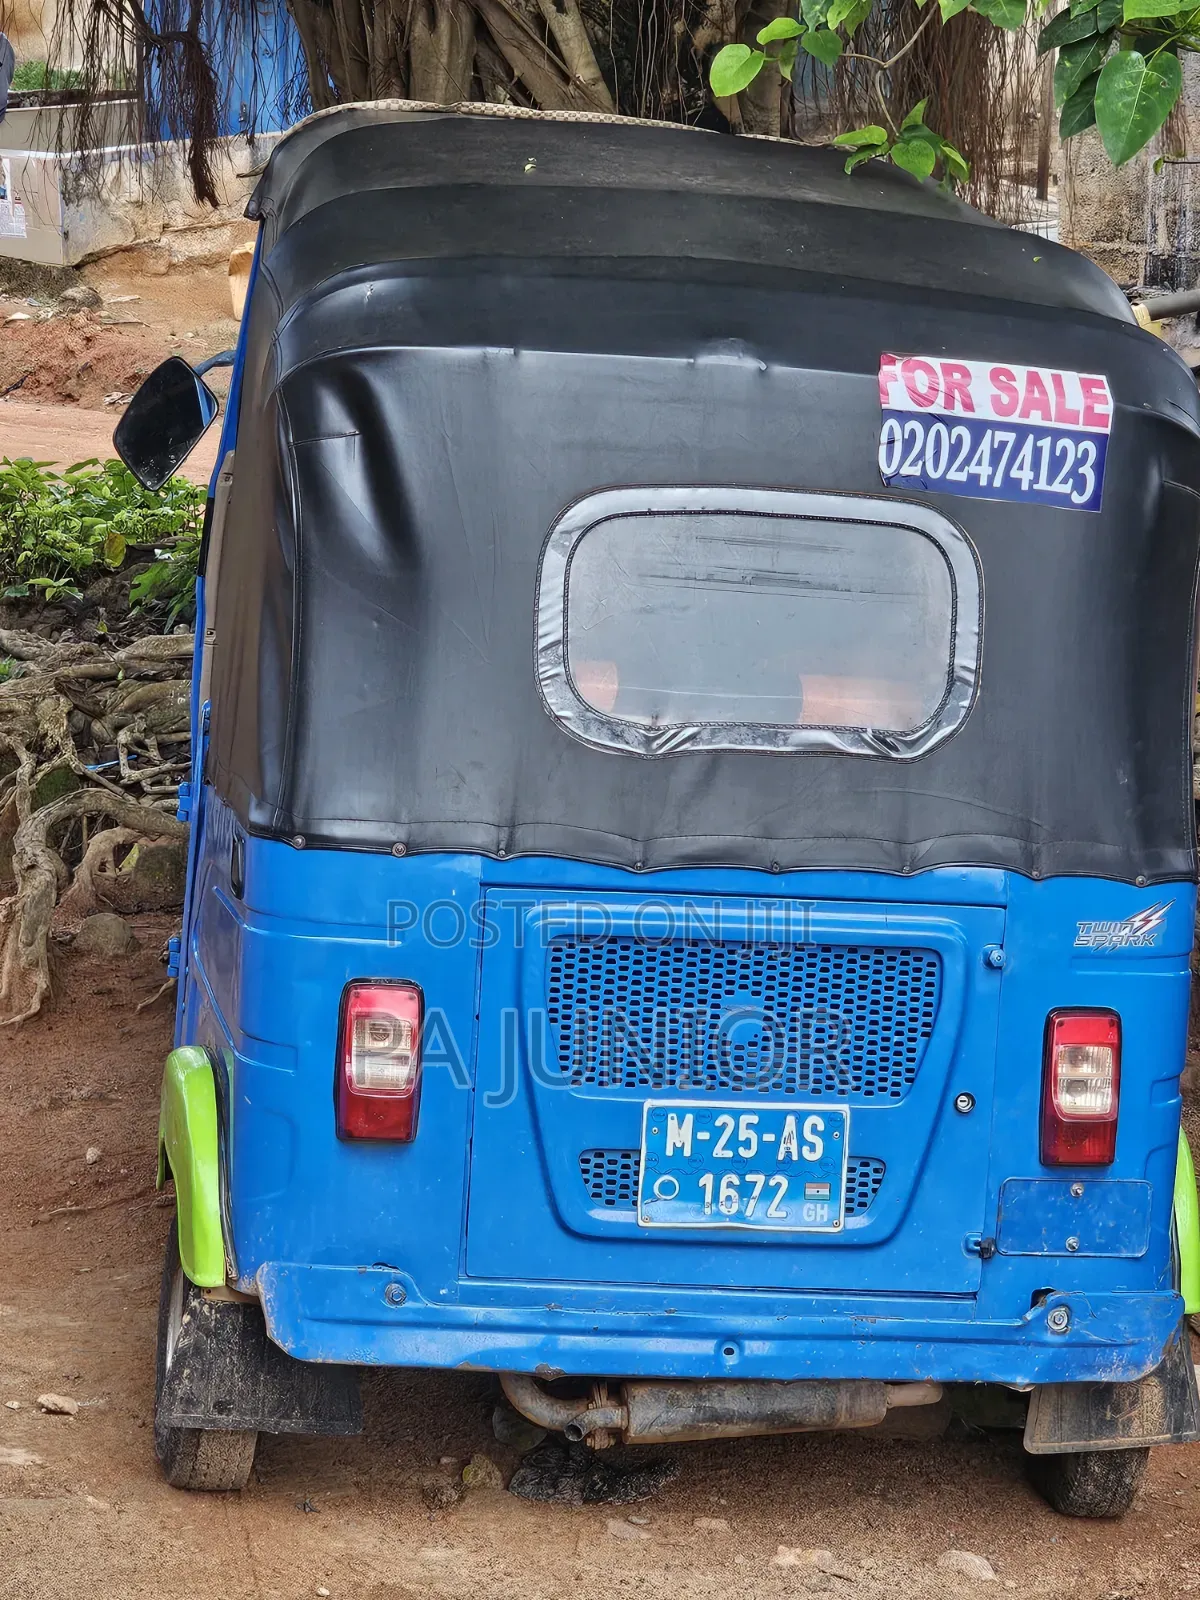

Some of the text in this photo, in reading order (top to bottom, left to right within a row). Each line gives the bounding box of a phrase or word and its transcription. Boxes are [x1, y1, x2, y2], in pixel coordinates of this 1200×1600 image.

[878, 353, 1110, 429] FOR SALE
[878, 418, 1098, 504] 0202474123
[1073, 934, 1158, 953] SPARK
[1076, 921, 1135, 934] TWIN
[665, 1112, 825, 1162] M-25-AS
[698, 1173, 790, 1219] 1672
[802, 1203, 829, 1222] GH
